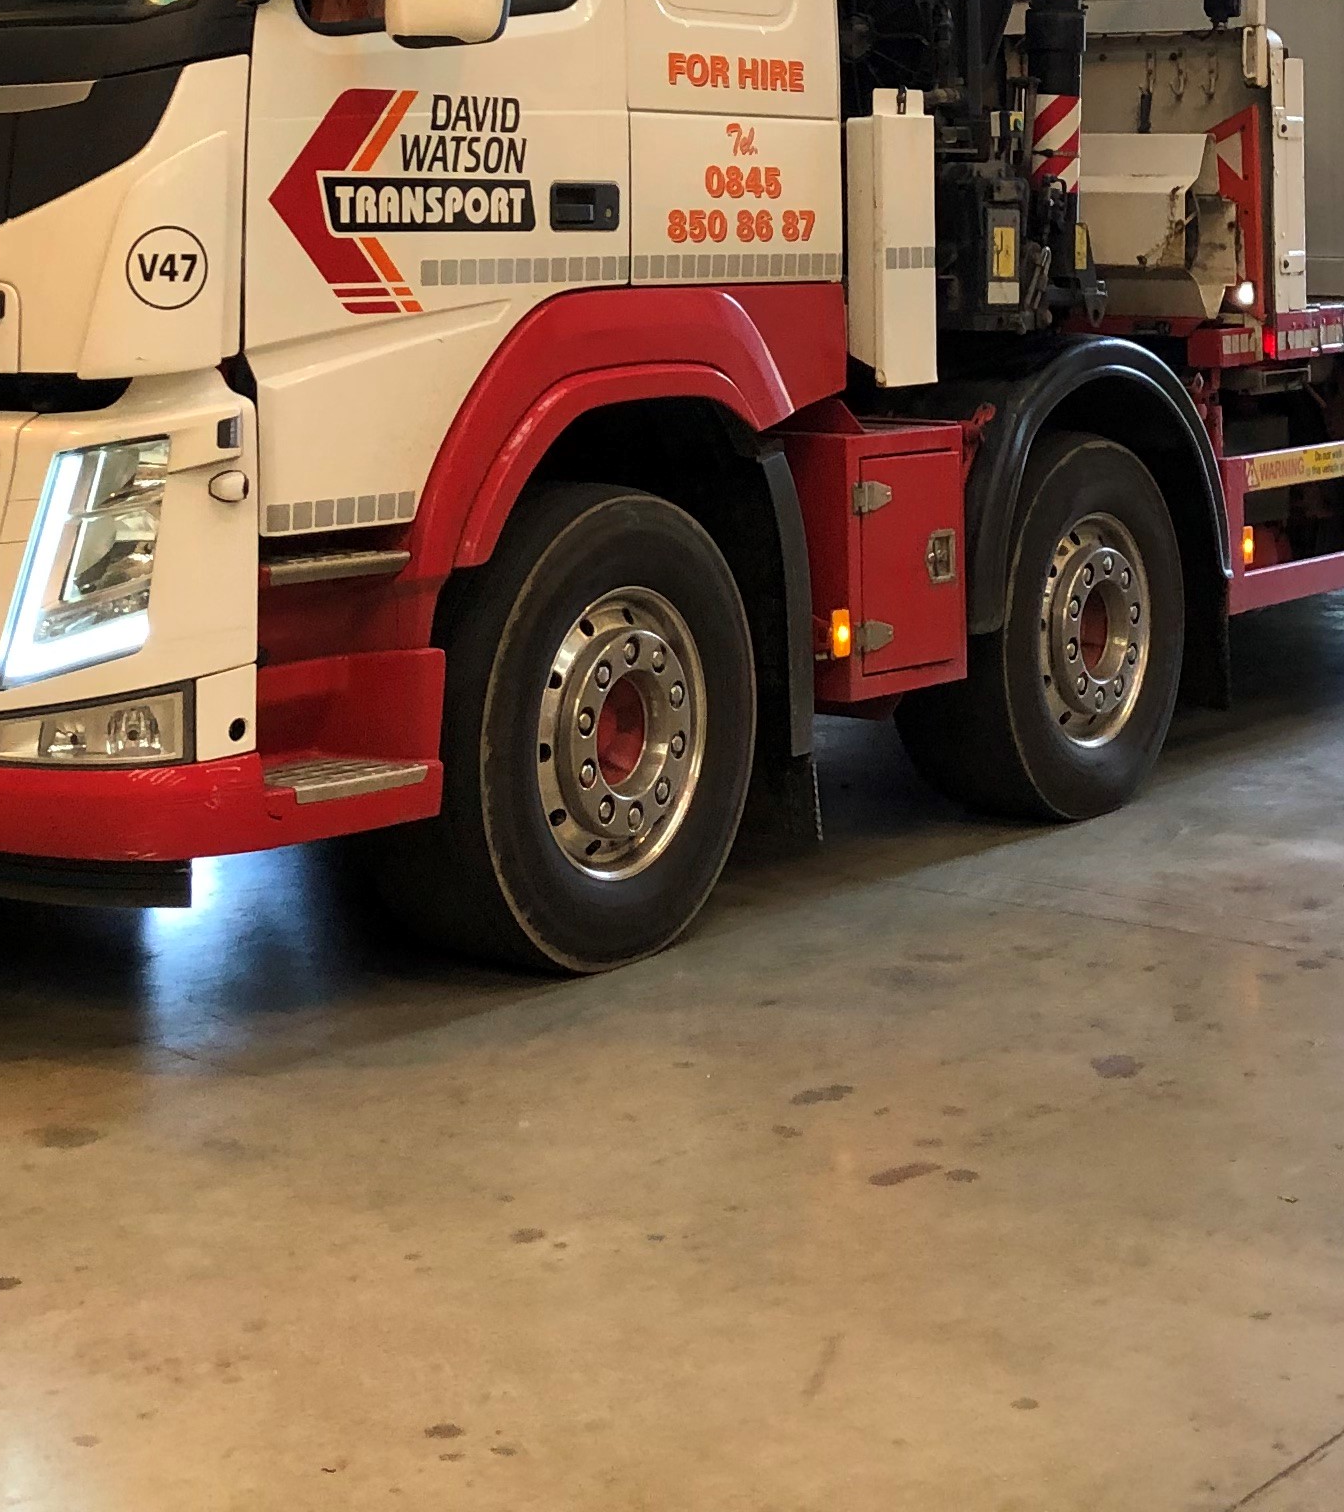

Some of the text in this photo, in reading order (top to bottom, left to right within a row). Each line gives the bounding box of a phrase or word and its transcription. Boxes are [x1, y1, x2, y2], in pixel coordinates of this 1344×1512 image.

[668, 52, 805, 93] FOR HIRE
[430, 94, 520, 133] DAVID
[400, 133, 528, 174] WATSON
[705, 165, 783, 200] 0845
[334, 185, 526, 225] TRANSPORT
[667, 209, 816, 244] 850 86 87
[137, 253, 197, 282] V47
[1259, 456, 1305, 481] WARNING
